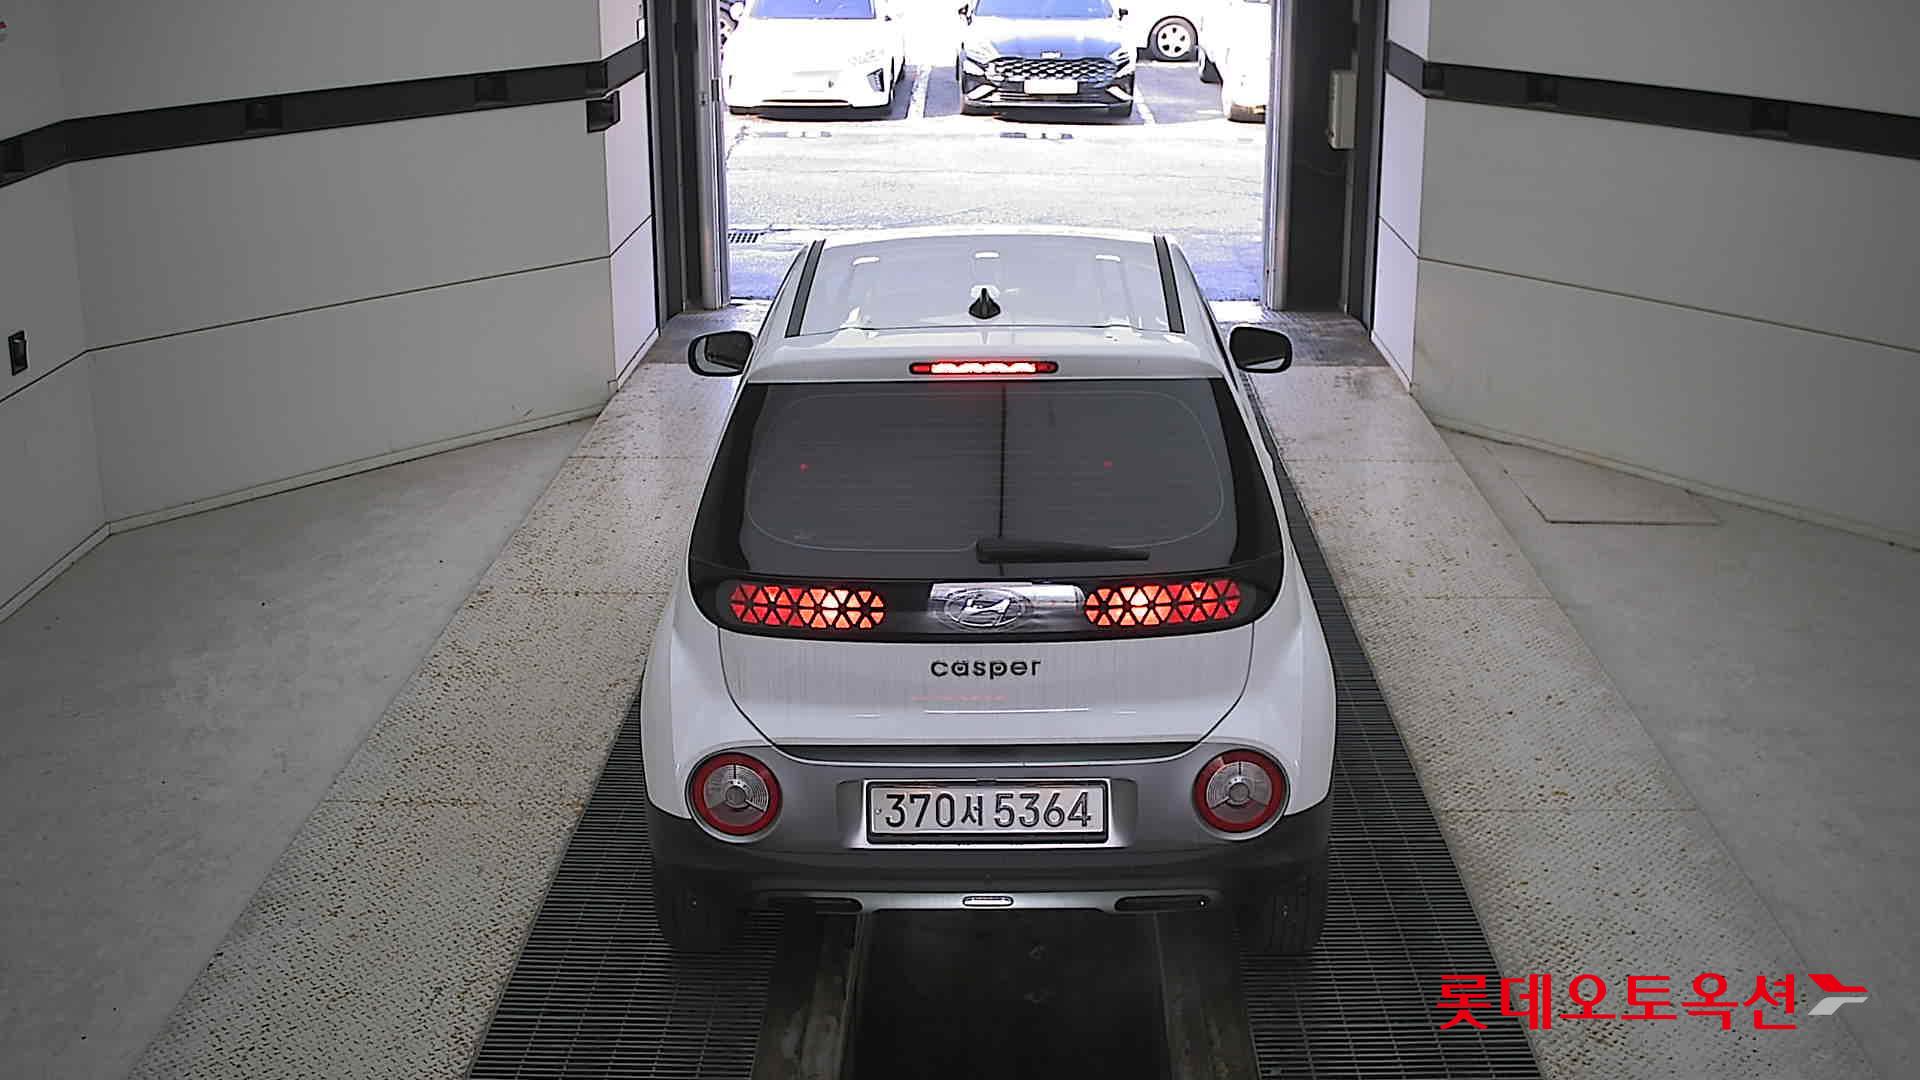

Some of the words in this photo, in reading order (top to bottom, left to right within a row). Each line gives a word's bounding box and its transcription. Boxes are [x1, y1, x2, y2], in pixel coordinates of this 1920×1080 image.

[930, 659, 1041, 680] casper
[885, 793, 984, 828] 370서
[994, 792, 1091, 827] 5364
